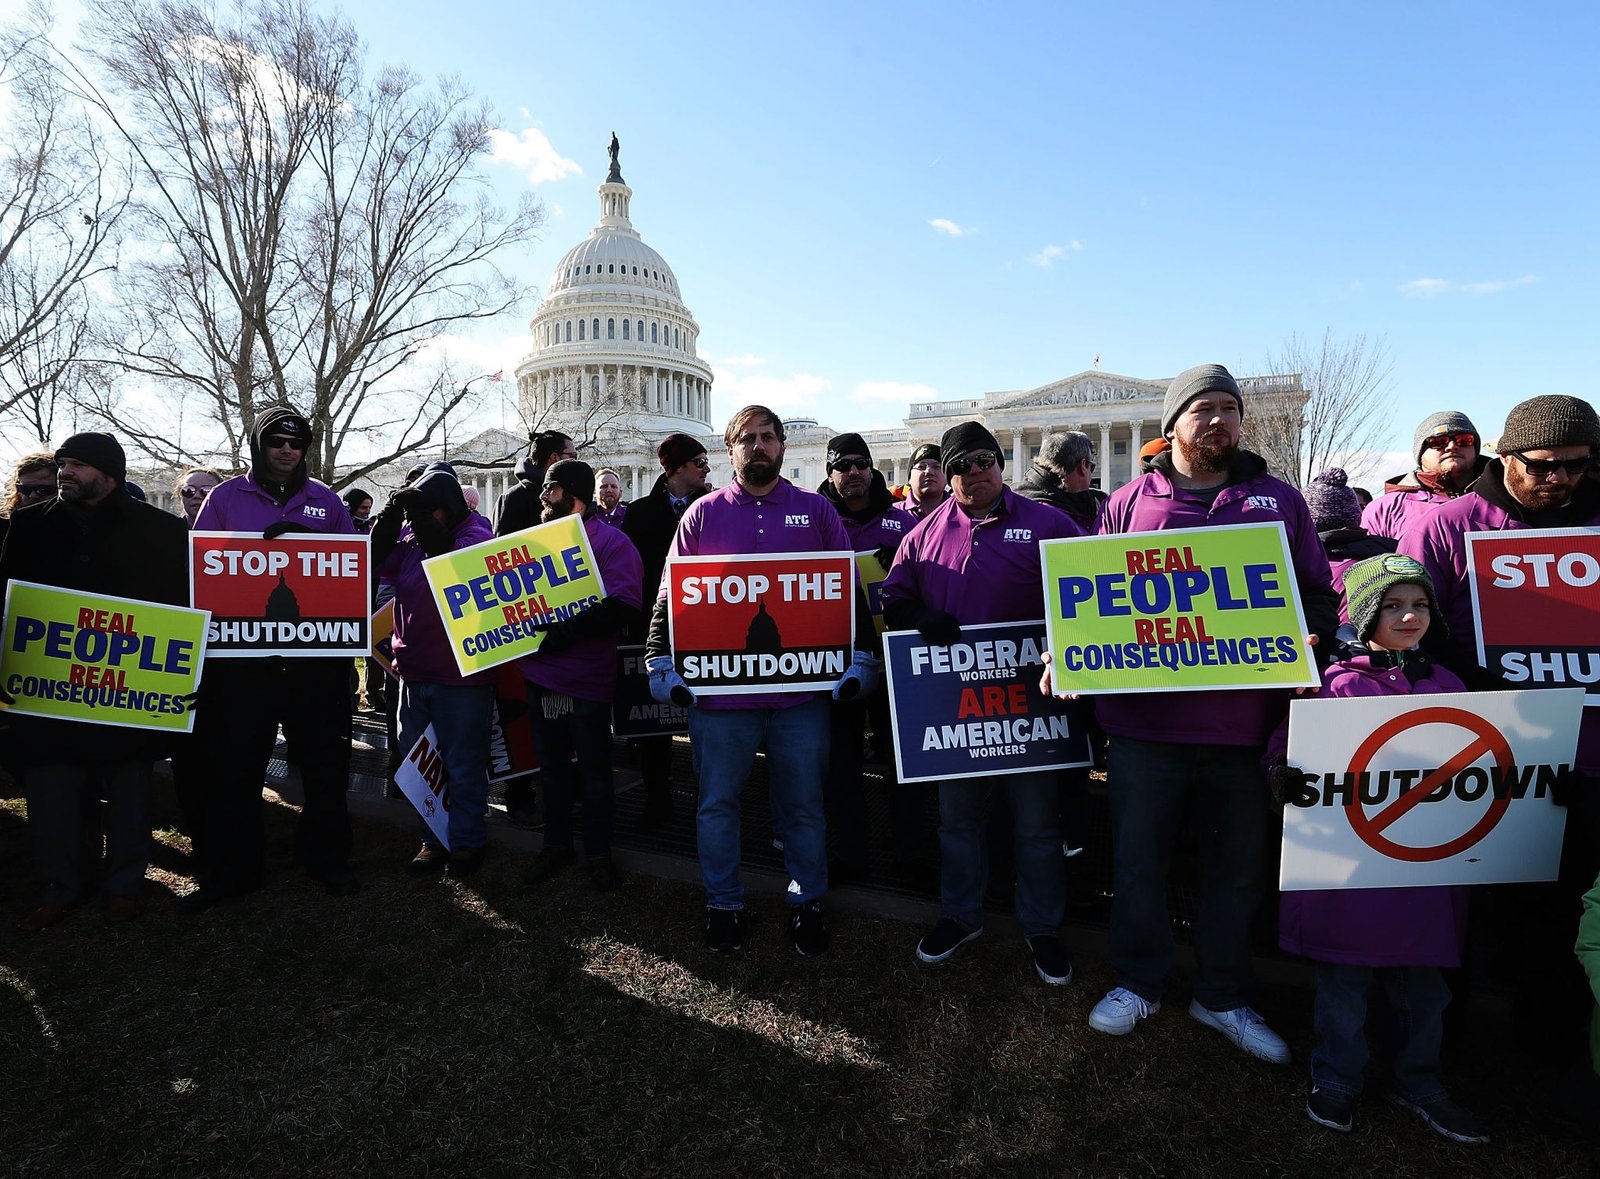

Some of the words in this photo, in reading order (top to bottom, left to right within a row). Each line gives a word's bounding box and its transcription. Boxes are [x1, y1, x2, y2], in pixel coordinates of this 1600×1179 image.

[303, 505, 326, 517] ATC
[1247, 496, 1277, 508] ATC
[785, 514, 809, 525] ATC
[881, 518, 901, 529] ATC
[1004, 529, 1032, 540] ATC
[203, 550, 290, 576] STOP
[297, 552, 359, 577] THE
[484, 544, 536, 577] REAL
[1125, 546, 1202, 576] REAL
[1491, 552, 1600, 589] STO
[443, 545, 591, 620] PEOPLE
[681, 574, 770, 605] STOP
[777, 572, 842, 602] THE
[1058, 563, 1286, 619] PEOPLE
[78, 607, 137, 636] REAL
[502, 594, 554, 625] REAL
[207, 621, 360, 643] SHUTDOWN
[1134, 615, 1214, 645] REAL
[13, 616, 193, 675] PEOPLE
[1065, 636, 1298, 671] CONSEQUENCES
[69, 664, 129, 693] REAL
[683, 650, 844, 679] SHUTDOWN
[959, 668, 1017, 681] WORKERS
[1501, 652, 1600, 683] SHU
[7, 674, 187, 714] CONSEQUENCES
[958, 683, 1029, 719] ARE
[922, 715, 1070, 751] AMERICAN
[969, 744, 1027, 758] WORKERS
